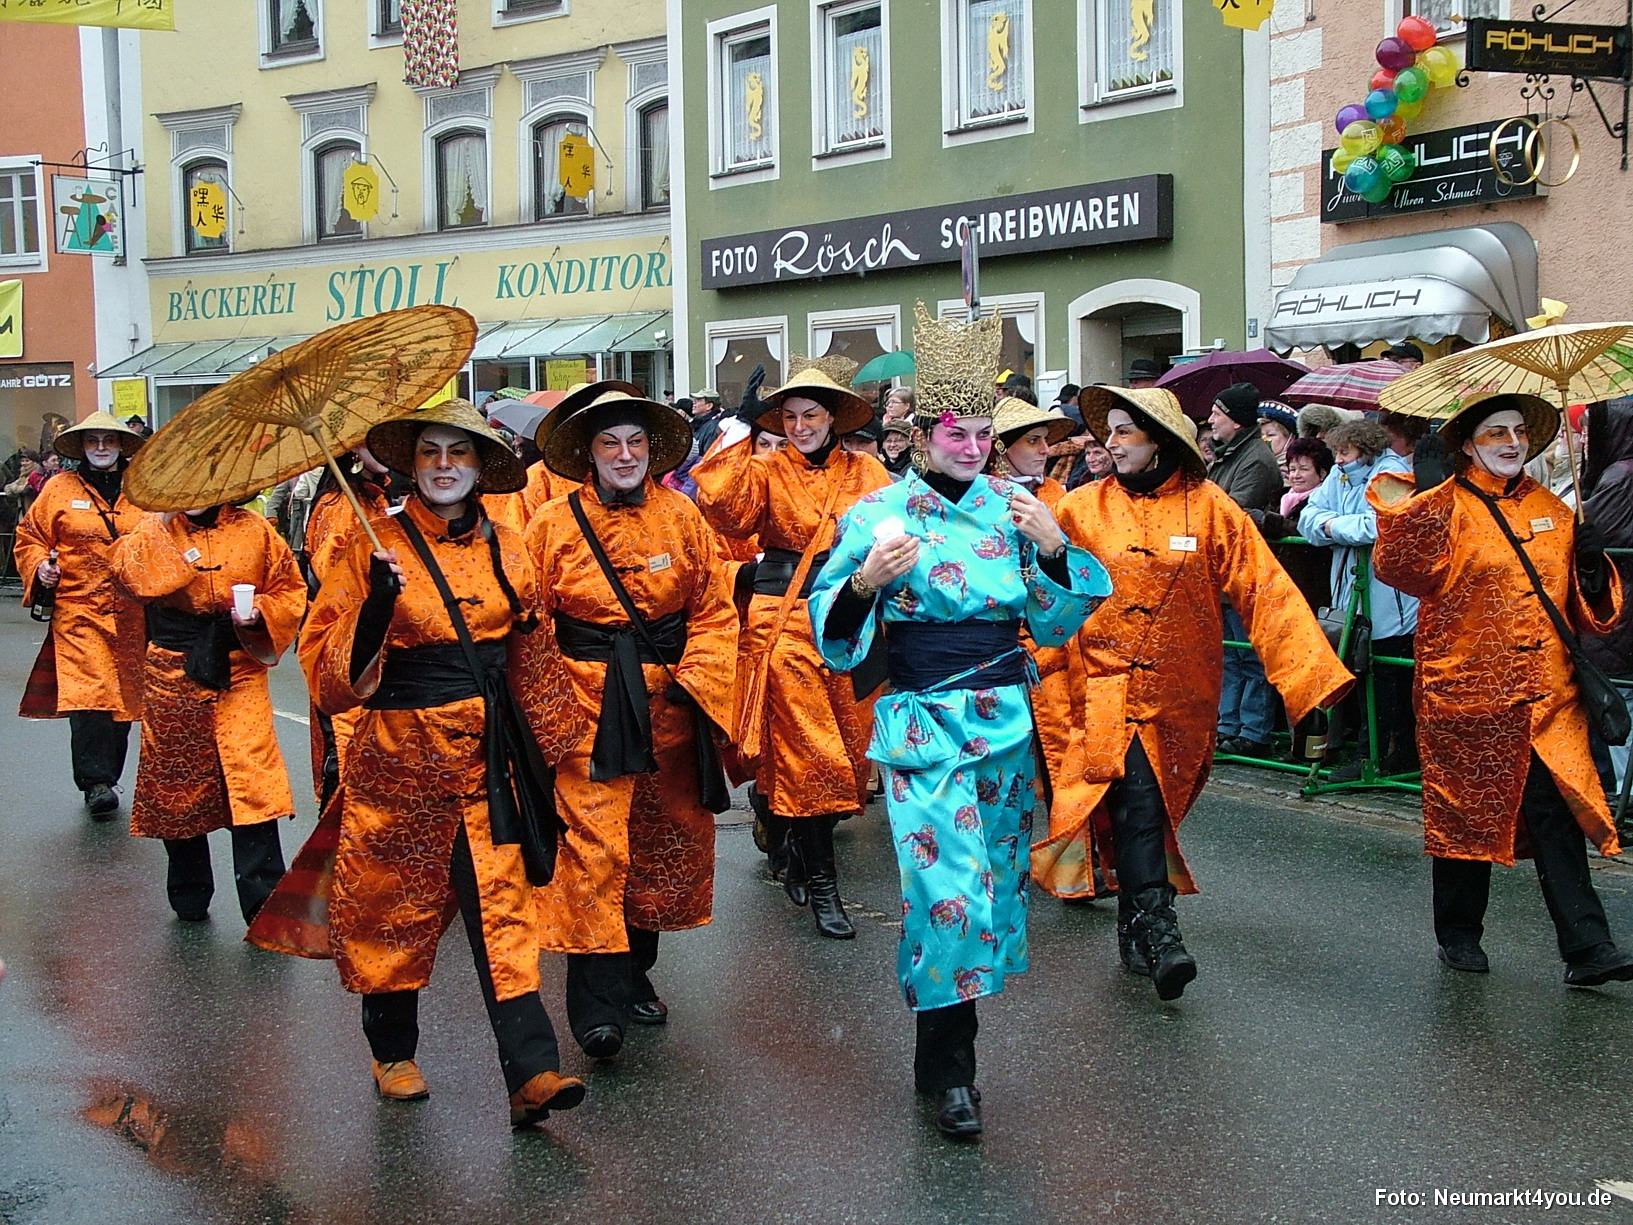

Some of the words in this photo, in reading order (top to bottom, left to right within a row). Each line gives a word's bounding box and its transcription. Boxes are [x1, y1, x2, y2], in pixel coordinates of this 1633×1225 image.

[1486, 27, 1614, 55] RÖHLICH
[1329, 126, 1524, 180] HLICH
[1394, 188, 1424, 209] Uhren
[1431, 178, 1483, 203] Schmuck
[711, 244, 758, 278] FOTO
[771, 222, 921, 279] Rösch
[940, 191, 1140, 250] SCHREIBWAREN
[167, 282, 297, 322] BÄCKEREI
[326, 262, 459, 322] STOLL
[495, 251, 673, 299] KONDITOR
[1274, 289, 1422, 319] RÖHLICH
[23, 374, 71, 388] GÖTZ
